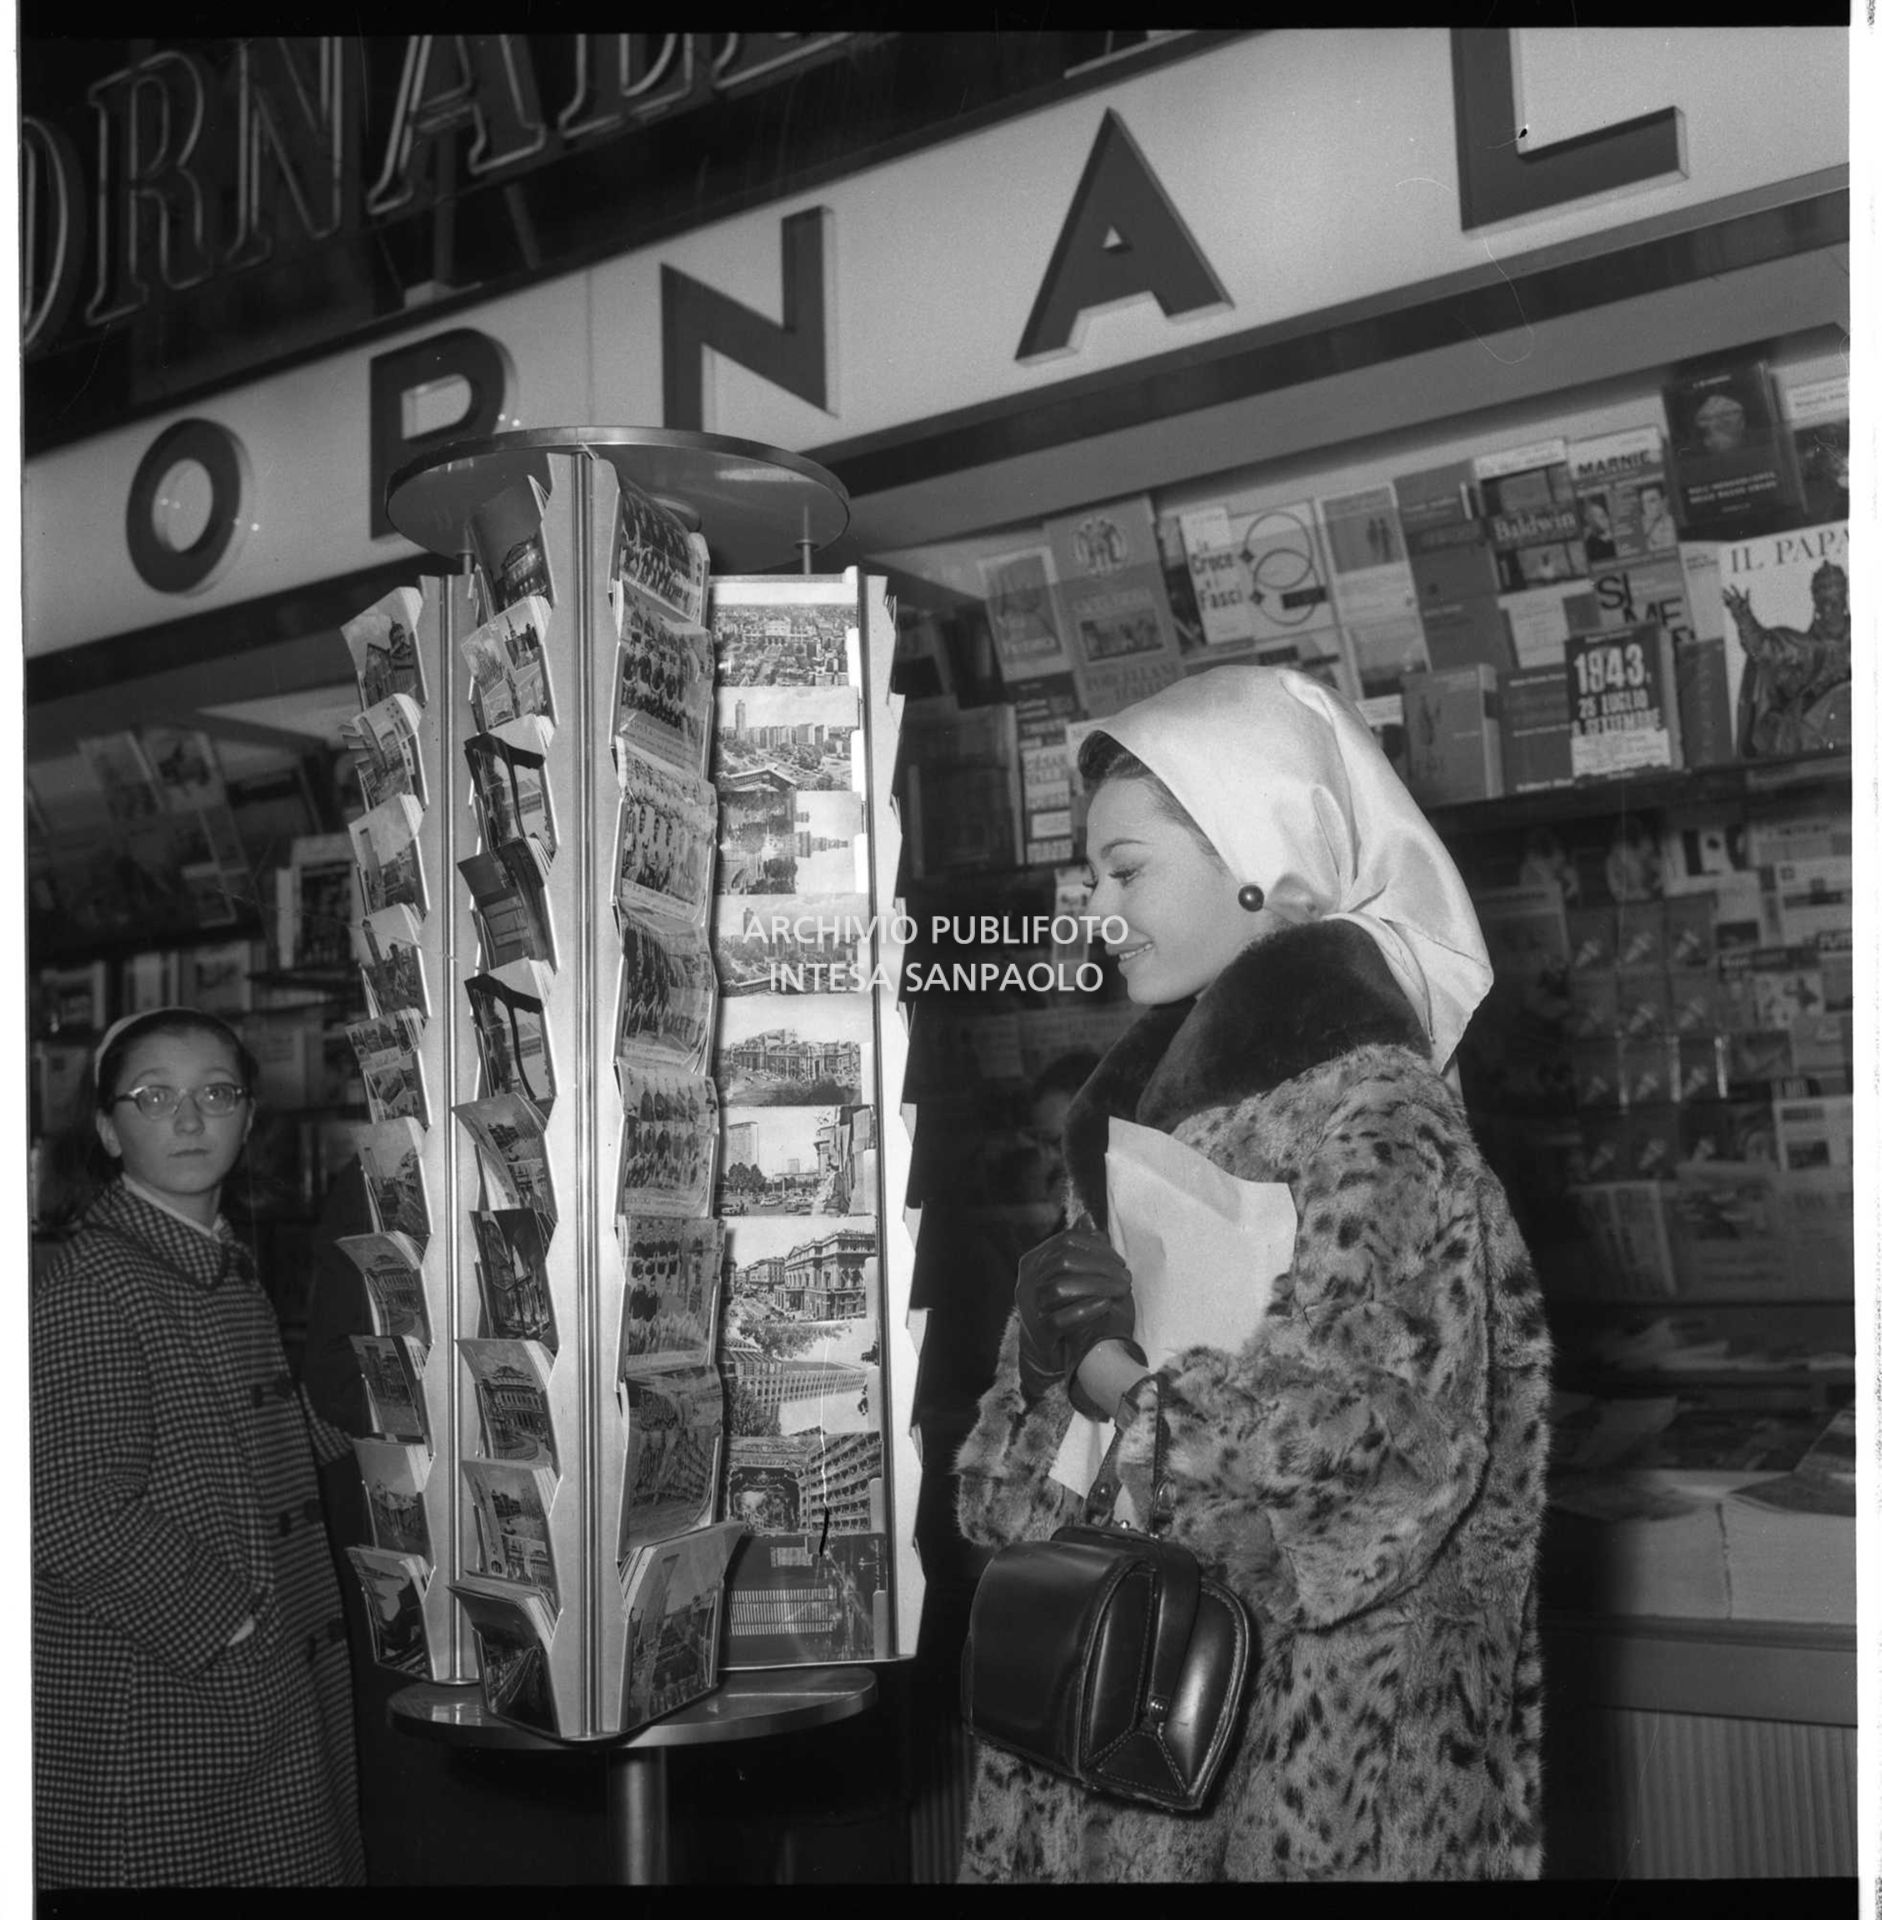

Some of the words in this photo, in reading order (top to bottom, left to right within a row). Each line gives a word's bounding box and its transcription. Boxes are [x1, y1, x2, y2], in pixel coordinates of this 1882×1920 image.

[1493, 509, 1577, 541] Baldwin
[1730, 546, 1765, 574] IL
[1601, 688, 1650, 717] LUGLIO
